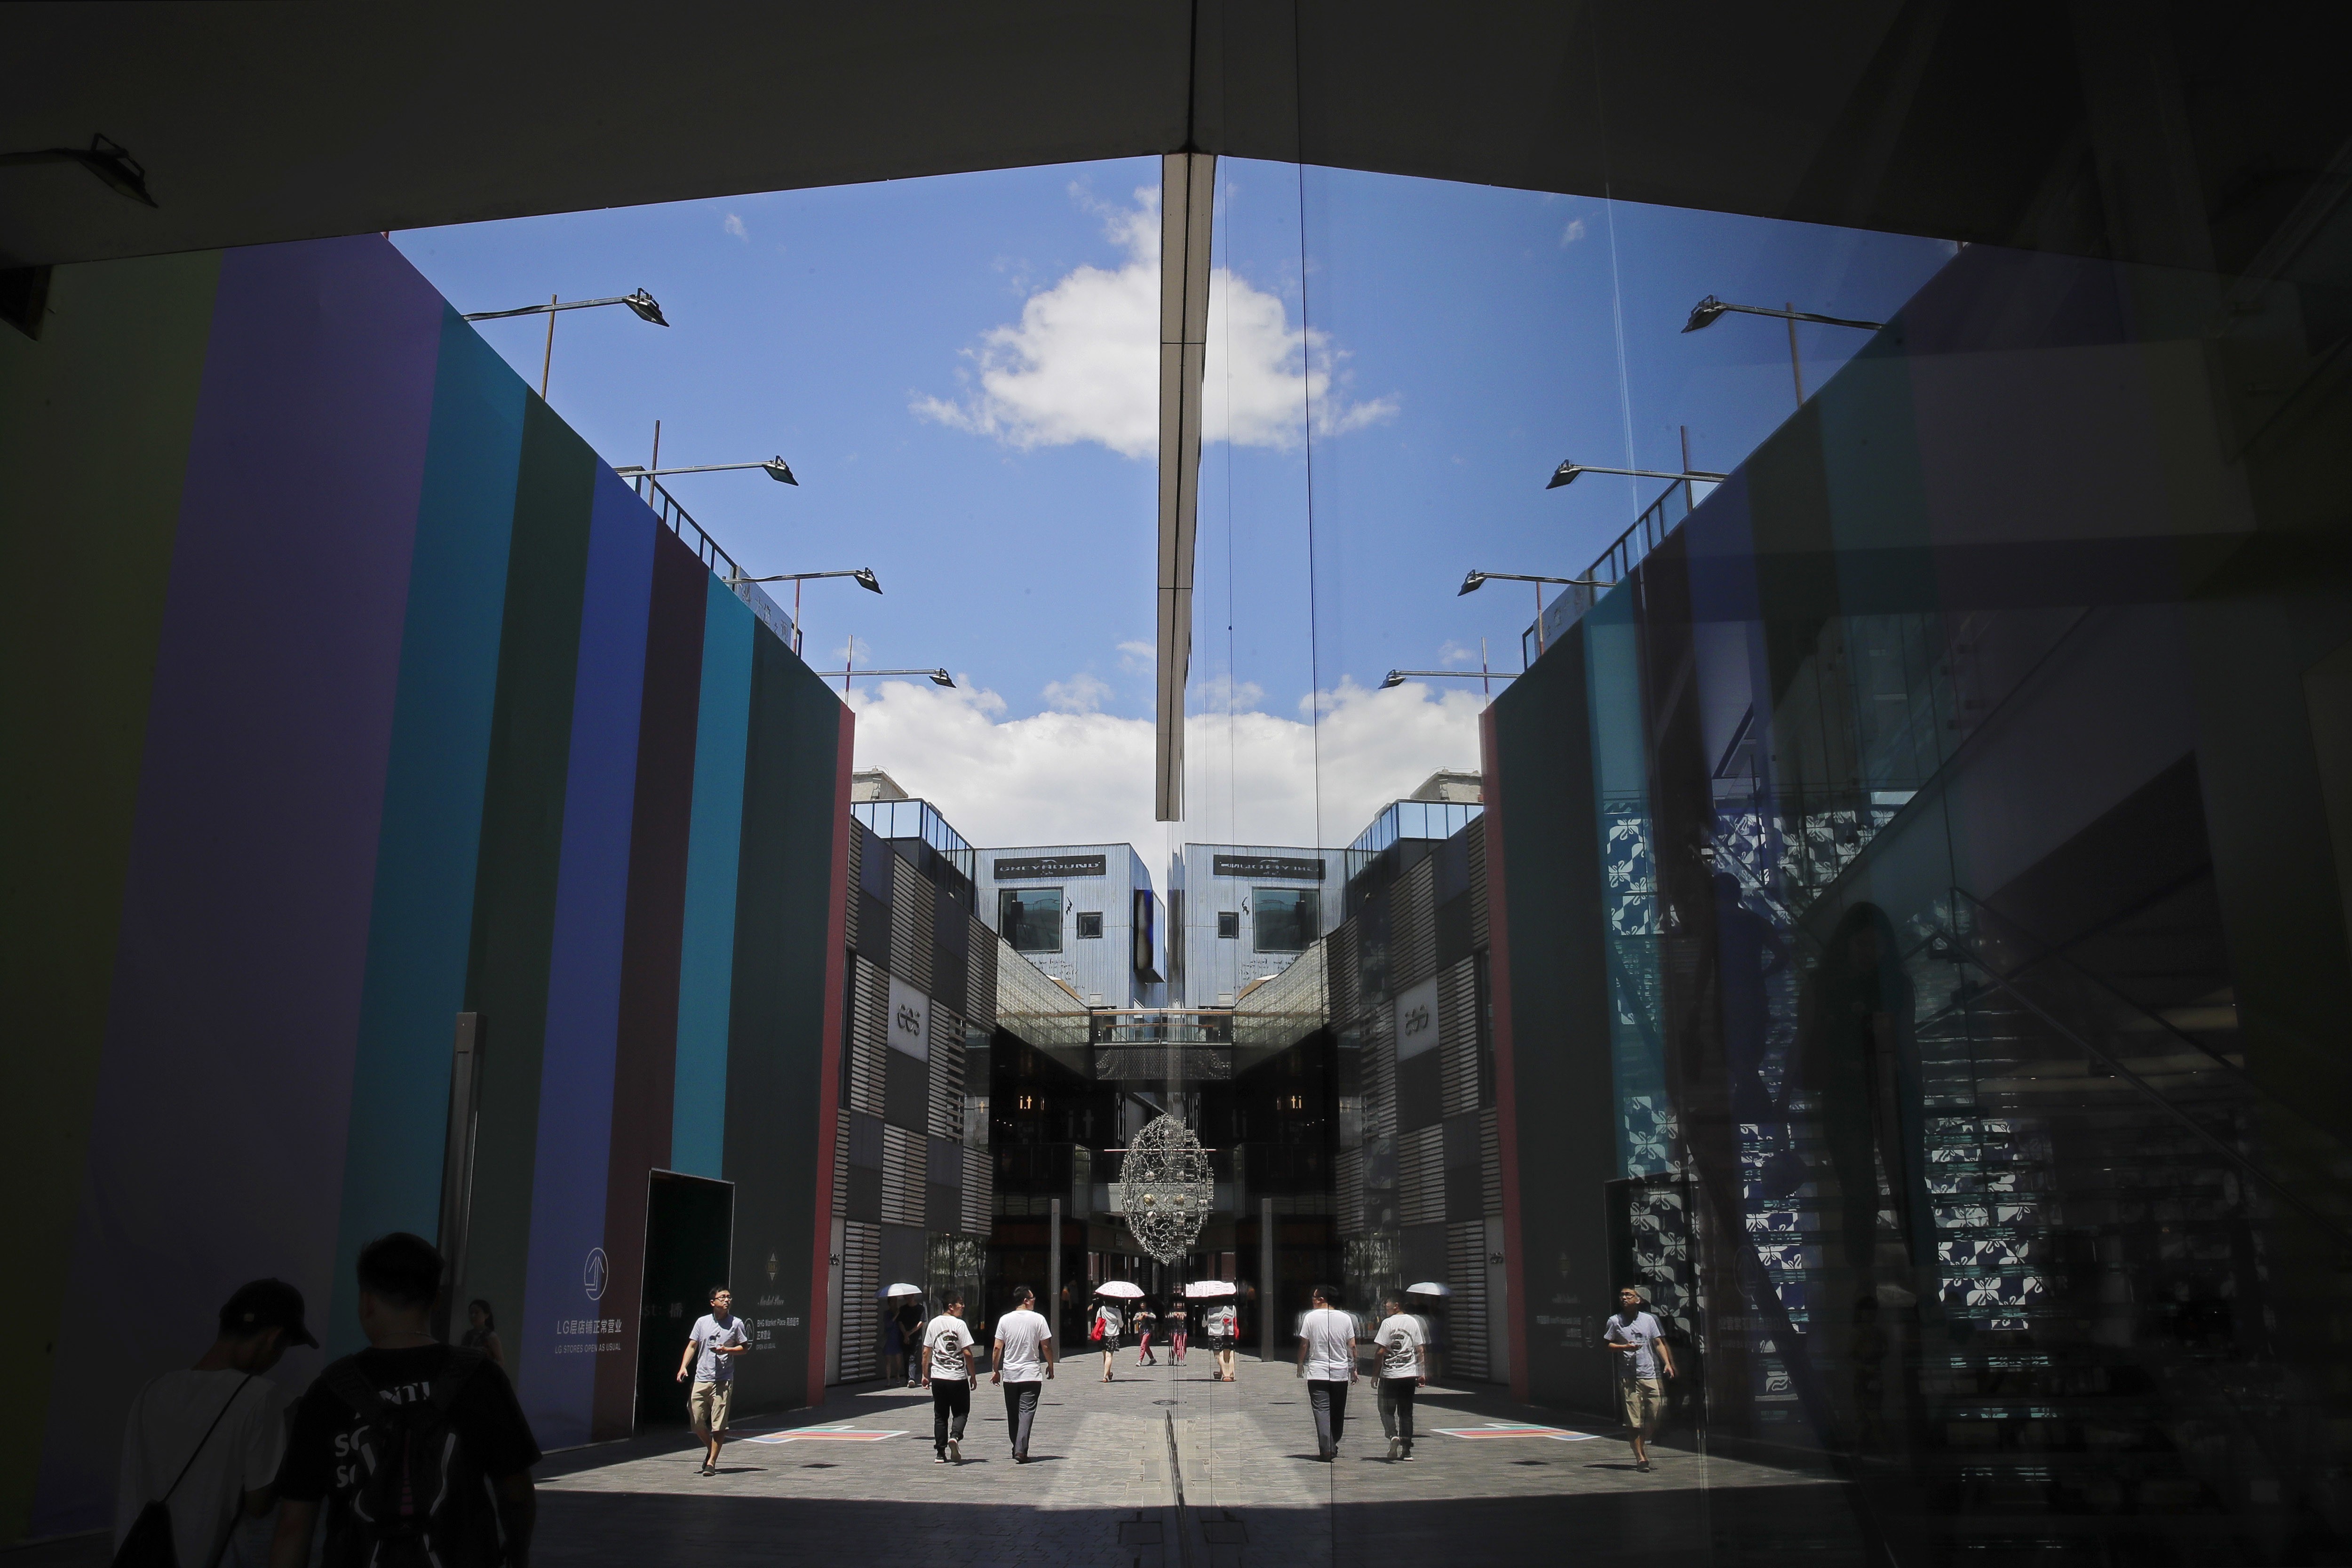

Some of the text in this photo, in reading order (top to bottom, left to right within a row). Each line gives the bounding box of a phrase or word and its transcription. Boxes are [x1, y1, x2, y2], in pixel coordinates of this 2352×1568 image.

[1019, 1095, 1032, 1109] i.t
[557, 1319, 622, 1335] LG层店铺正常营业
[555, 1342, 621, 1354] LG STORES OPEN AS USUAL
[379, 1381, 430, 1405] NTI
